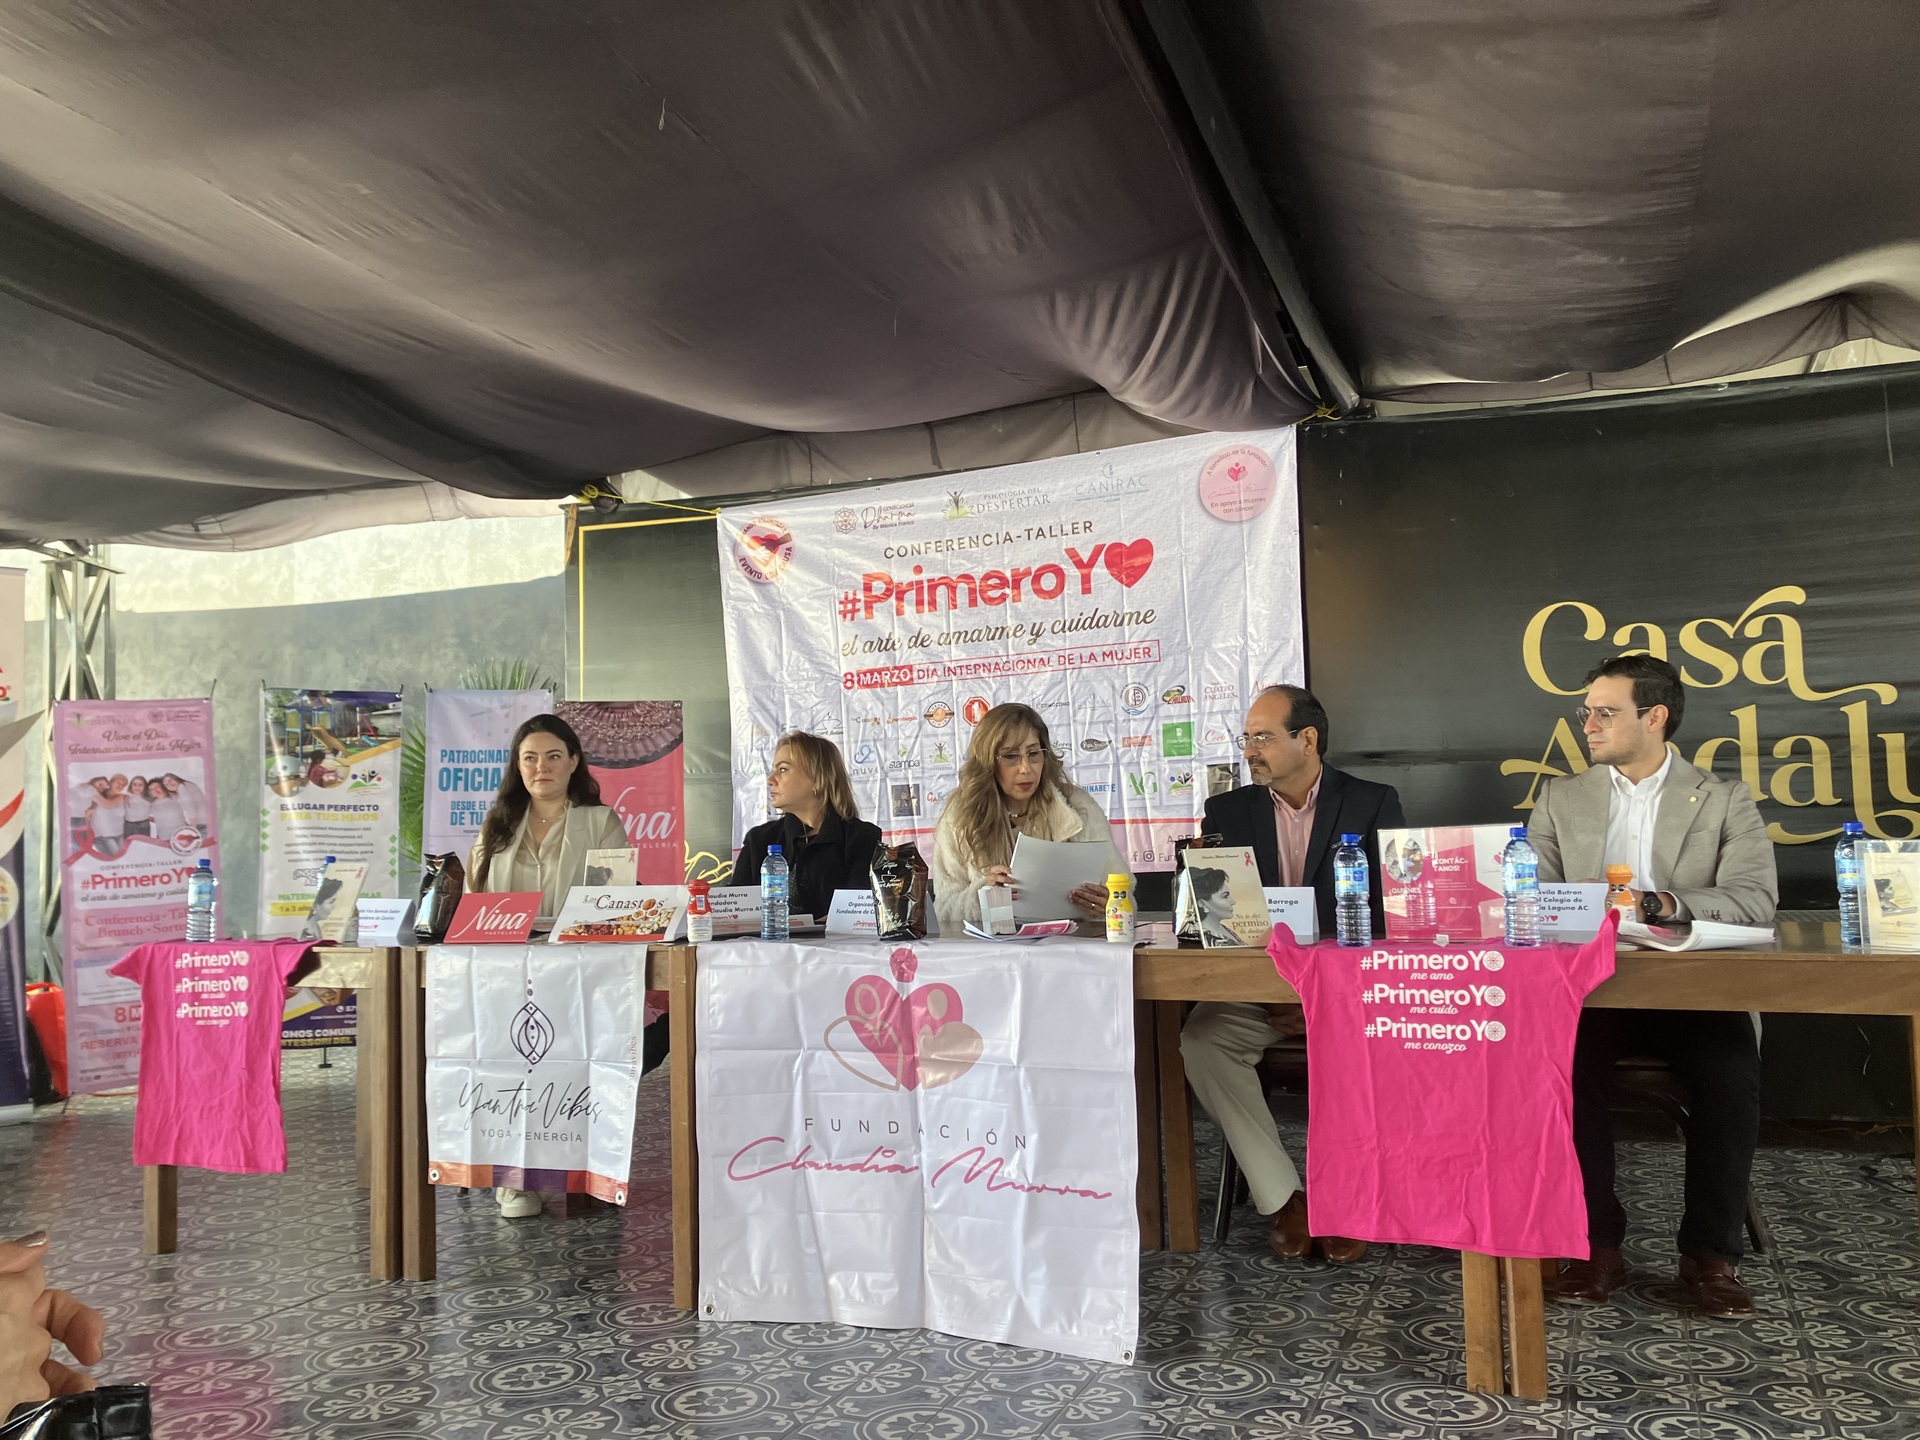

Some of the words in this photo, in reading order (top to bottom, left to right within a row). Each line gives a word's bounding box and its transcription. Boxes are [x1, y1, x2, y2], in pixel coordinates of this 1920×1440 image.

[1210, 450, 1231, 471] beneficio
[1247, 450, 1268, 468] fundación
[1075, 475, 1148, 496] CANIRAC
[977, 494, 1051, 514] DESPERTAR
[1243, 497, 1266, 505] mujeres
[884, 520, 1093, 559] CONFERENCIA-TALLER
[739, 557, 762, 579] EVENTO
[841, 634, 858, 656] el
[862, 632, 902, 655] arte
[907, 626, 933, 649] de
[936, 620, 1025, 647] amarme
[1027, 620, 1046, 646] y
[1050, 606, 1157, 635] cuidarme
[842, 671, 857, 691] 8
[858, 667, 912, 686] MARZO
[916, 664, 940, 681] DÍA
[941, 656, 1055, 679] INTERNACIONAL
[1057, 653, 1077, 668] DE
[1079, 650, 1099, 664] LA
[1101, 645, 1152, 662] MUJER
[1204, 684, 1235, 694] CUATRO
[1203, 692, 1237, 702] ANGELES
[102, 730, 131, 742] Vive
[132, 731, 142, 741] el
[68, 743, 139, 755] Internacional
[141, 743, 154, 752] de
[156, 741, 166, 751] la
[169, 739, 202, 753] Mujer
[889, 759, 920, 770] stampa
[1500, 699, 1920, 845] Adalu
[291, 803, 325, 811] LUGAR
[326, 804, 380, 812] PERFECTO
[451, 800, 478, 811] DESDE
[479, 801, 488, 811] EL
[280, 812, 312, 821] PARA
[316, 812, 339, 821] TUS
[341, 812, 379, 821] HIJOS
[450, 811, 468, 826] DE
[470, 811, 483, 825] TU
[109, 890, 120, 901] de
[1268, 898, 1299, 906] Borrego
[1543, 896, 1571, 904] Colegio
[1548, 904, 1576, 912] Laguna
[84, 913, 160, 928] Conferencia
[451, 898, 529, 938] Nina
[1232, 919, 1268, 931] permiso
[97, 926, 144, 938] Brunch
[1410, 973, 1427, 981] me
[1429, 973, 1455, 981] amo
[114, 1007, 127, 1023] 8
[1409, 1006, 1427, 1014] me
[1428, 1004, 1459, 1015] cuido
[80, 1036, 138, 1050] RESERVA
[1404, 1042, 1421, 1050] me
[1423, 1042, 1467, 1055] conozco
[480, 1128, 512, 1139] YOGA
[525, 1130, 583, 1143] ENERGÍA
[804, 1117, 1028, 1149] FUNDACIÓN
[727, 1136, 920, 1182] Claudia
[931, 1146, 1112, 1200] Murra
